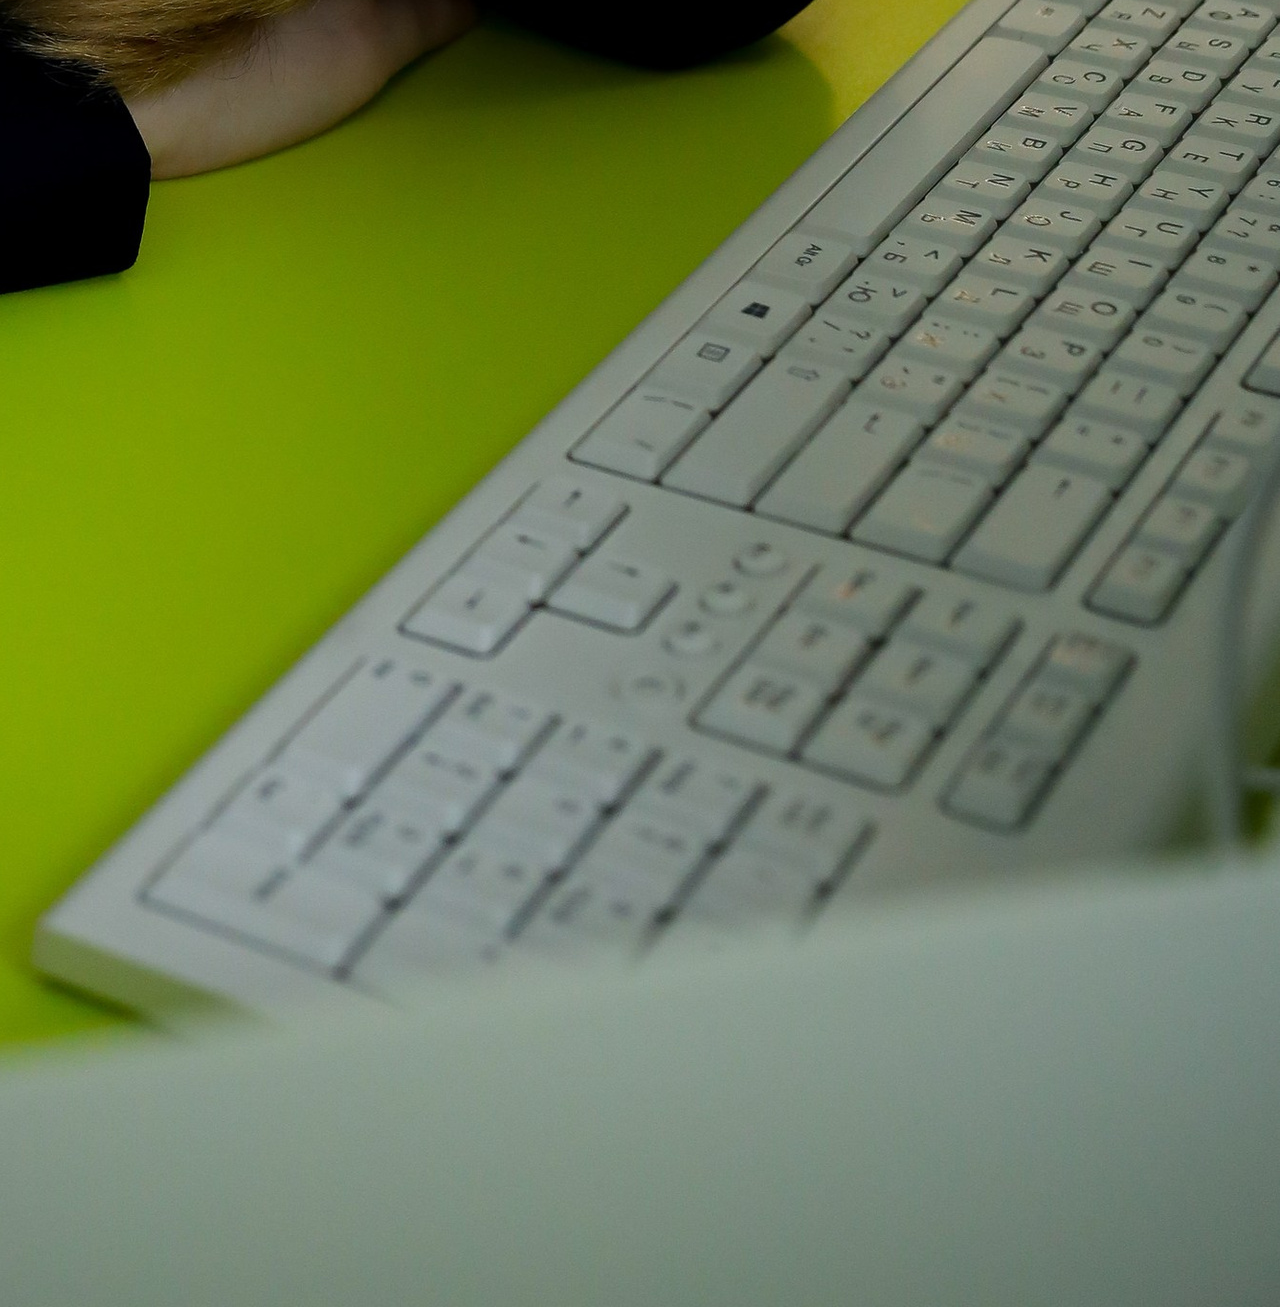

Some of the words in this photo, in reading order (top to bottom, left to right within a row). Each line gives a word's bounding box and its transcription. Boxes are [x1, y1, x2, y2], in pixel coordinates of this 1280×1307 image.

[1142, 8, 1166, 19] Z
[1112, 38, 1137, 50] X
[1208, 38, 1232, 48] S
[1083, 71, 1106, 83] C
[1182, 71, 1207, 82] D
[1053, 105, 1077, 116] V
[1155, 103, 1177, 115] F
[1245, 113, 1272, 126] R
[1022, 137, 1047, 149] B
[1120, 139, 1147, 152] G
[1219, 151, 1244, 161] T
[987, 173, 1015, 187] N
[1089, 173, 1118, 187] H
[1188, 188, 1214, 198] Y
[953, 209, 982, 226] M
[1060, 210, 1082, 222] J
[1239, 216, 1257, 226] 7
[1156, 221, 1184, 235] U
[1024, 248, 1052, 263] K
[991, 287, 1018, 296] L
[1091, 301, 1117, 316] O
[1062, 340, 1086, 357] P
